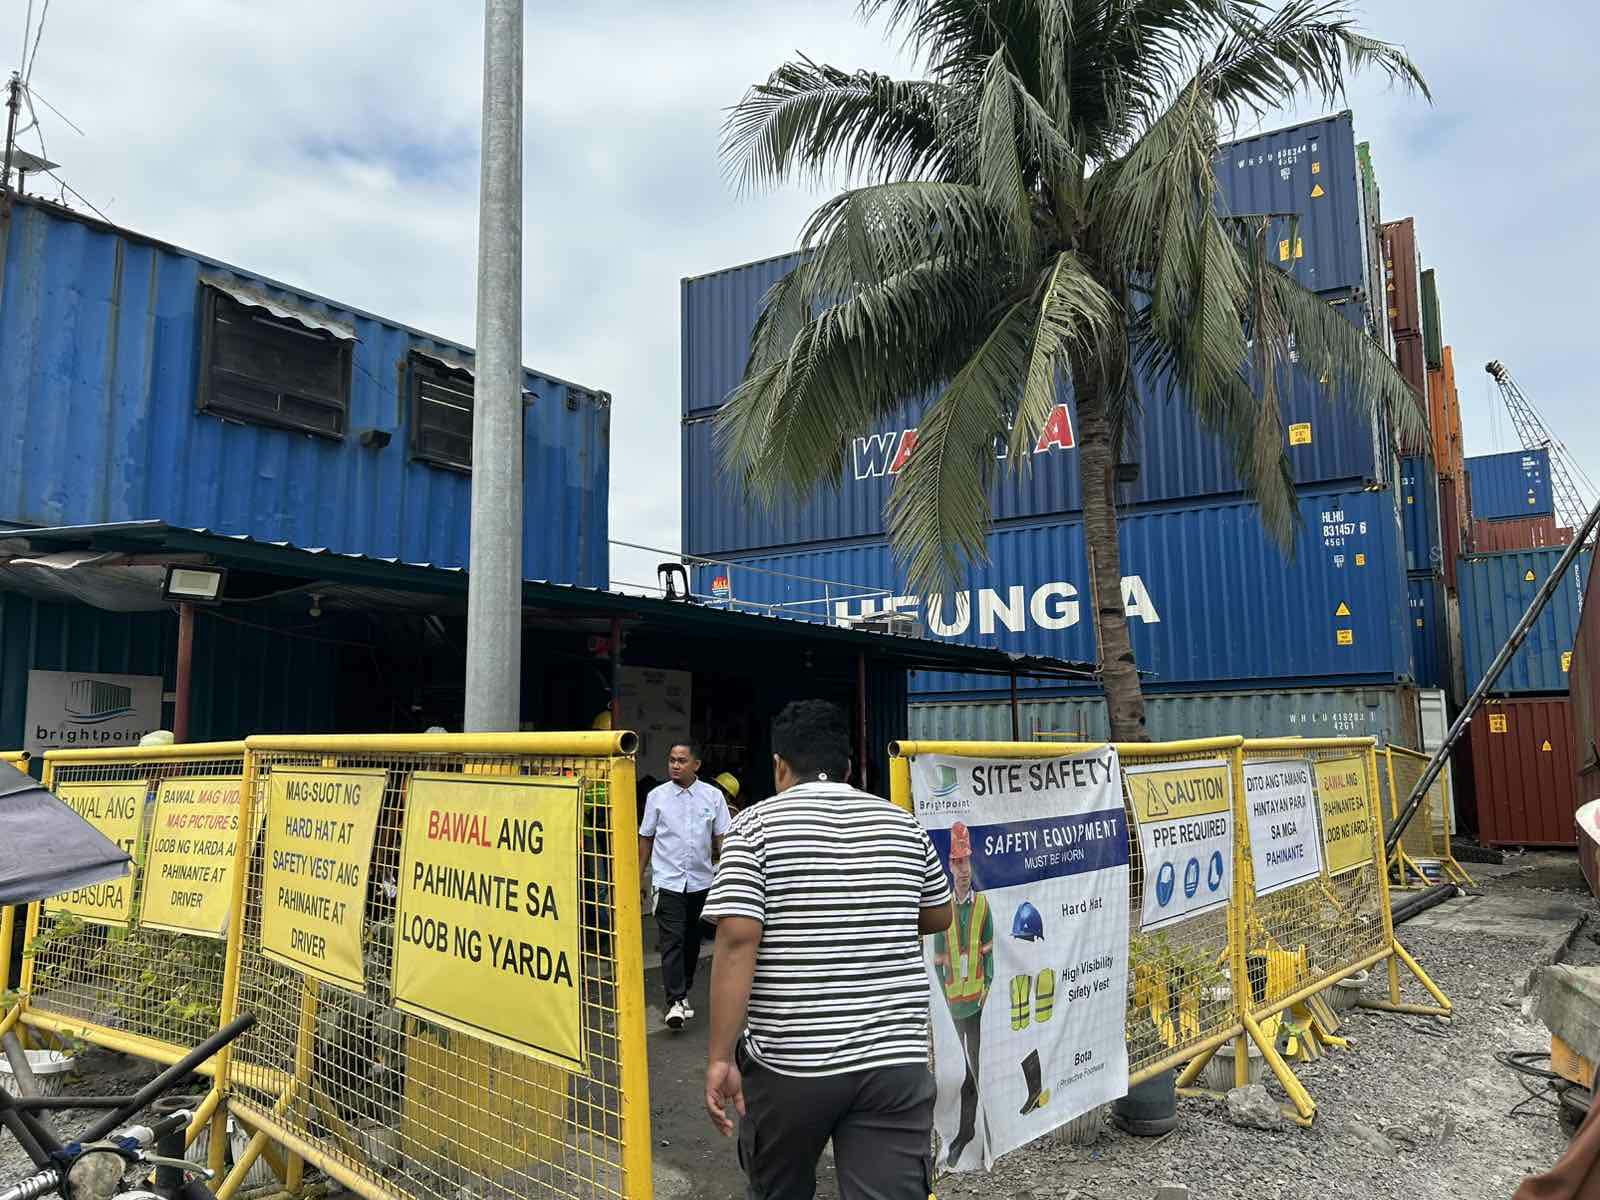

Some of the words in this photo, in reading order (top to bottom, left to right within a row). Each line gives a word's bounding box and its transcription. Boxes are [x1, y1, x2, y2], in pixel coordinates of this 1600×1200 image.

[1321, 510, 1344, 523] HLHU
[1323, 523, 1355, 537] 831457
[1359, 522, 1367, 535] 6
[972, 764, 1022, 796] SITE
[1028, 755, 1113, 791] SAFETY
[1247, 776, 1264, 792] DITO
[1265, 774, 1280, 789] ANG
[1280, 770, 1307, 787] TAMANG
[163, 790, 194, 803] BAWAL
[198, 790, 221, 804] MAG
[286, 781, 342, 804] MAG-SUOT
[344, 784, 361, 806] NG
[1164, 777, 1224, 805] CAUTION
[62, 797, 101, 819] AWAL
[105, 797, 136, 820] ANG
[1253, 797, 1289, 816] HINTAYAN
[1289, 794, 1306, 811] PARA
[167, 814, 186, 829] MAG
[187, 815, 231, 830] PICTURE
[230, 815, 239, 830] S
[285, 815, 313, 839] HARD
[314, 819, 337, 842] HAT
[338, 823, 354, 845] AT
[428, 810, 492, 848] BAWAL
[496, 817, 545, 855] ANG
[1153, 826, 1177, 849] PPE
[1179, 818, 1227, 844] REQUIRED
[1270, 825, 1281, 840] SA
[1281, 821, 1297, 837] MGA
[1325, 825, 1341, 844] OOB
[1341, 823, 1350, 838] NG
[154, 838, 176, 853] LOOB
[177, 839, 191, 854] NG
[192, 840, 225, 857] YARDA
[984, 830, 1037, 856] SAFETY
[1043, 819, 1117, 848] EQUIPMENT
[1024, 854, 1048, 870] MUST
[1050, 853, 1060, 865] BE
[1061, 847, 1085, 863] WORN
[1265, 844, 1304, 866] PAHINANTE
[162, 864, 210, 882] PAHINANTE
[210, 868, 227, 884] AT
[272, 850, 308, 876] SAFETY
[309, 856, 336, 881] VEST
[336, 862, 360, 887] ANG
[72, 884, 124, 910] BASURA
[170, 890, 203, 908] DRIVER
[412, 861, 519, 913] PAHINANTE
[525, 881, 559, 921] SA
[278, 886, 331, 921] PAHINANTE
[331, 901, 346, 926] AT
[1061, 900, 1087, 917] Hard
[1089, 897, 1103, 911] Hat
[290, 927, 326, 960] DRIVER
[402, 912, 449, 953] LOOB
[454, 926, 482, 963] NG
[488, 934, 573, 988] YARDA
[1061, 964, 1080, 983] High
[1081, 955, 1114, 975] Visibility
[1068, 984, 1091, 1003] Safety
[1093, 977, 1110, 992] Vest
[1074, 1050, 1092, 1066] Bota
